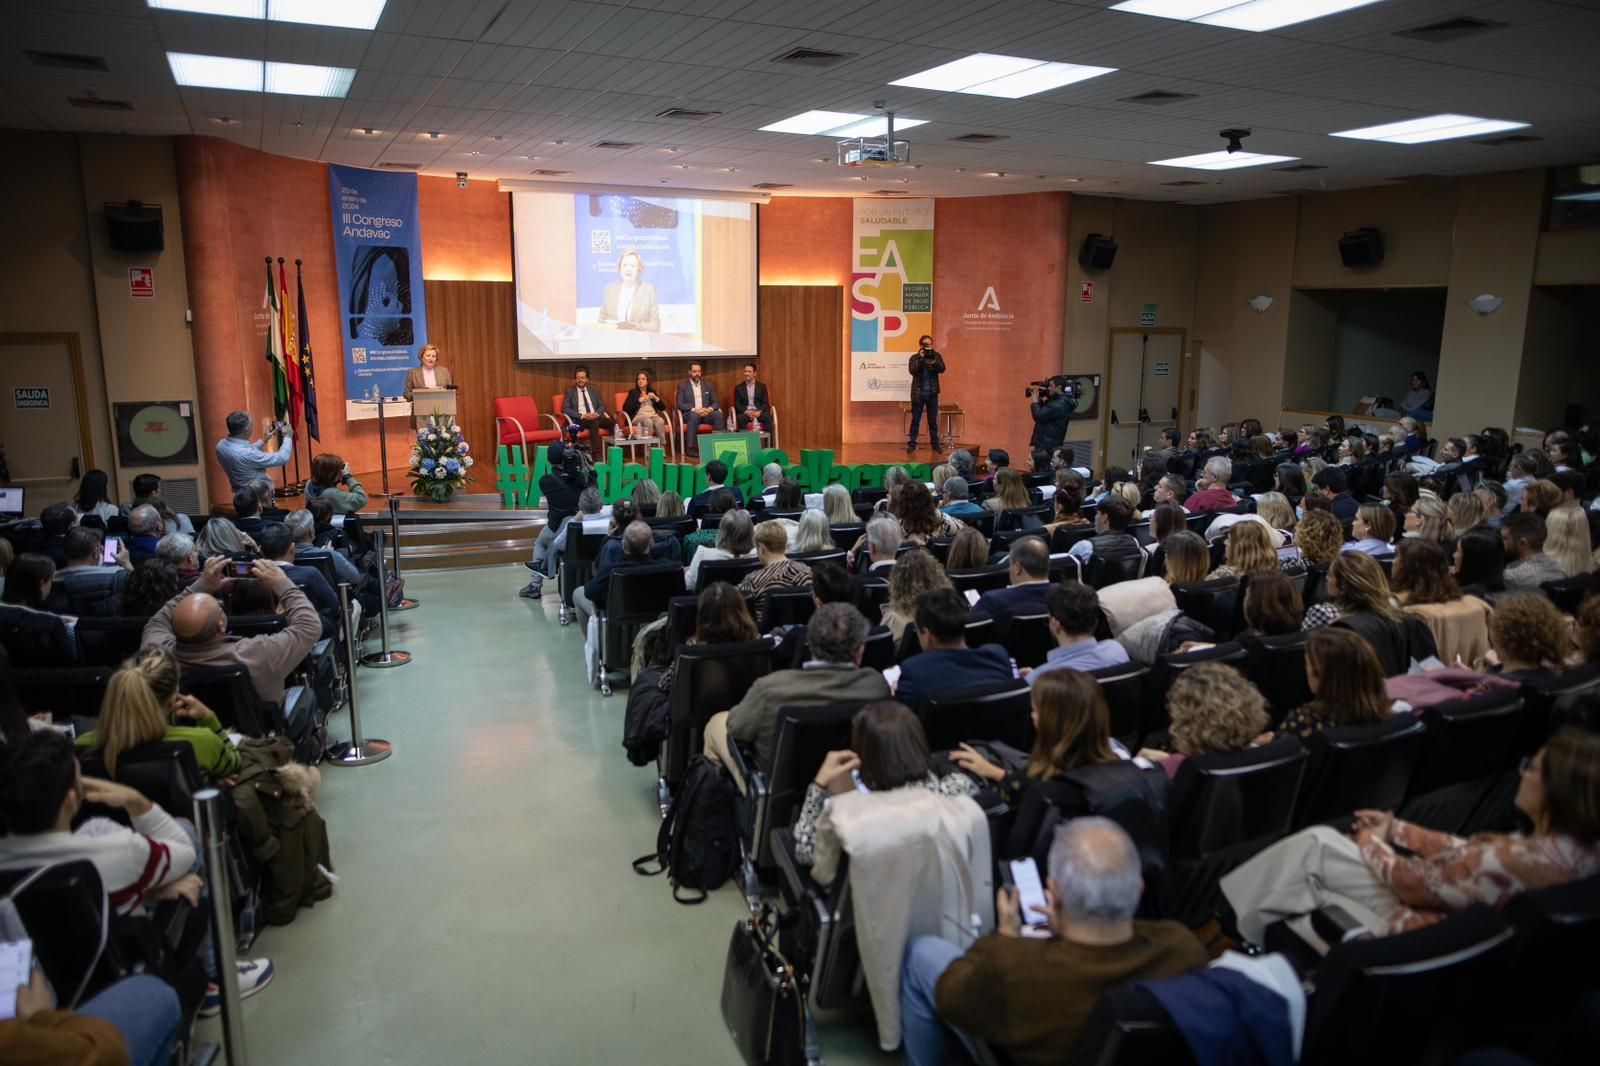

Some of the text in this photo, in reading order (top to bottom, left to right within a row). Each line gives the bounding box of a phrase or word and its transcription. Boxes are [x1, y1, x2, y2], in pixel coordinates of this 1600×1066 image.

[343, 213, 403, 228] III Congreso
[343, 225, 391, 239] Andavac
[16, 390, 48, 399] SALIDA
